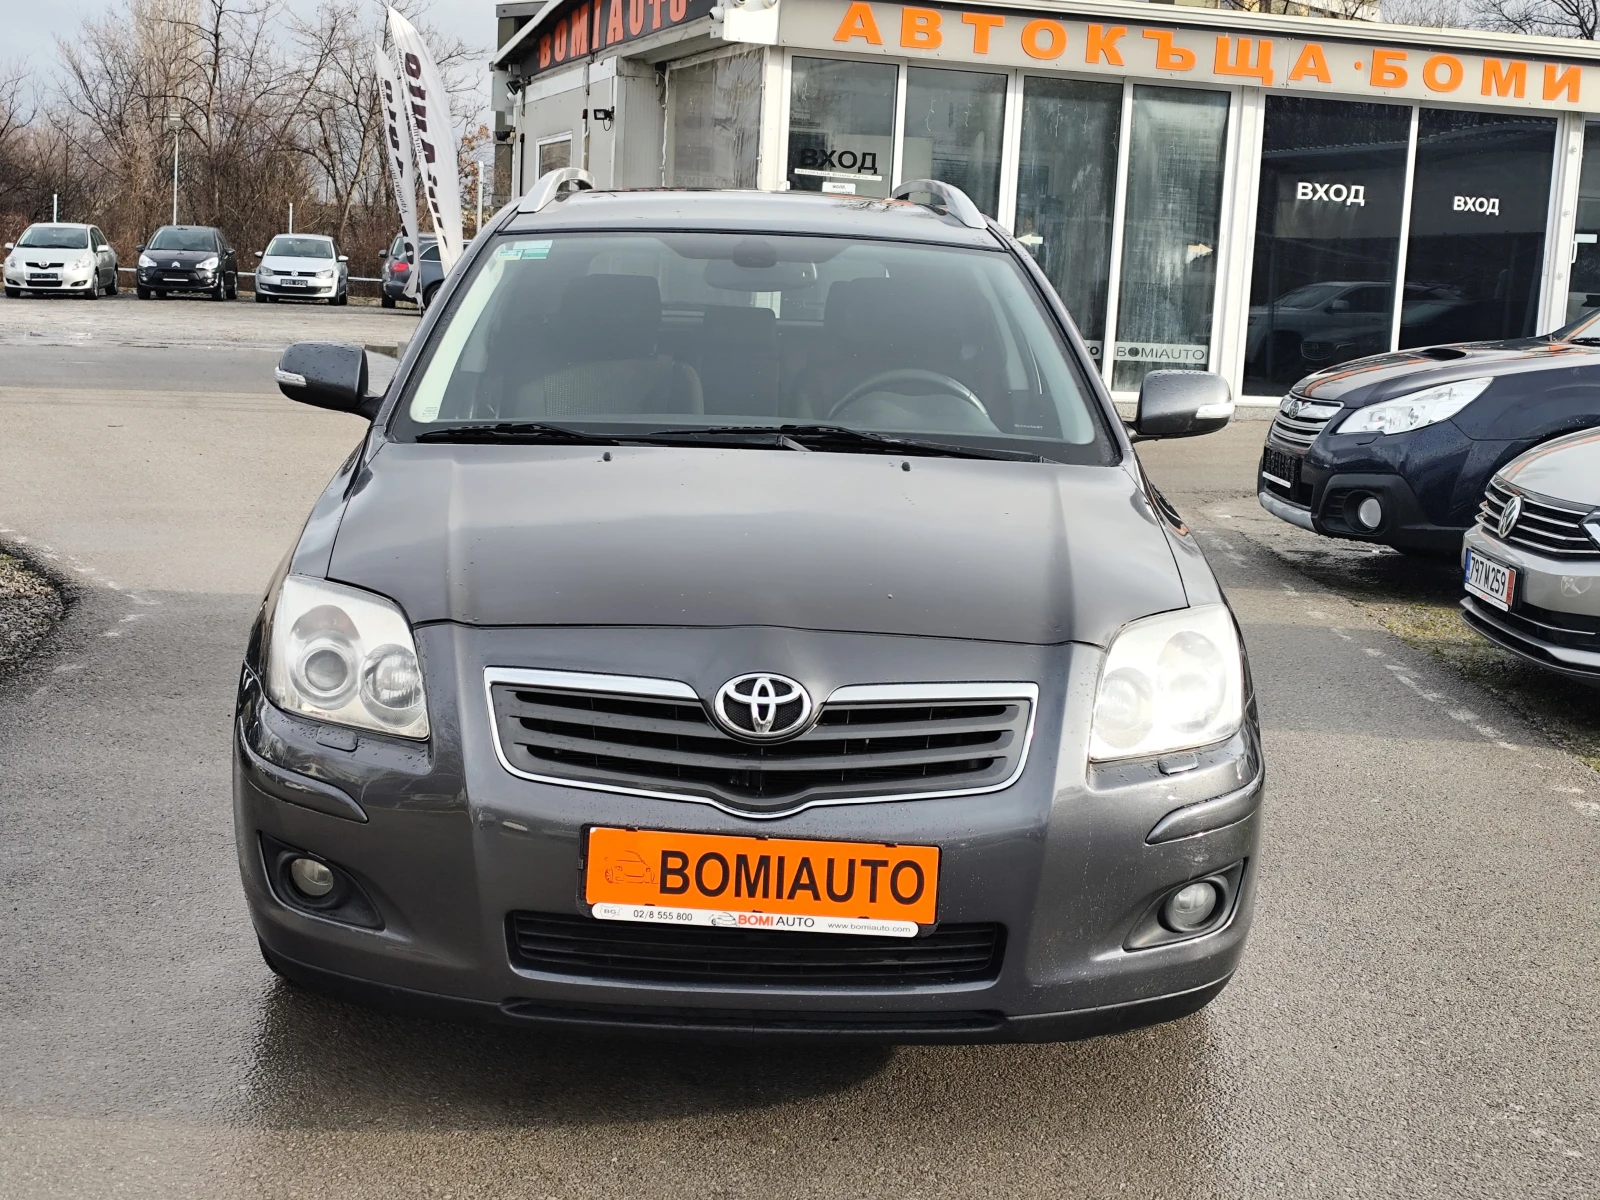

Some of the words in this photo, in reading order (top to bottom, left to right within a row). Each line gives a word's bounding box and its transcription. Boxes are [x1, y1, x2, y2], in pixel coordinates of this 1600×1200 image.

[833, 2, 1332, 86] АВТОКЪЩА
[801, 148, 877, 174] ВХОД
[1297, 182, 1365, 206] ВХОД
[1453, 196, 1500, 216] ВХОД
[659, 850, 925, 905] BOMIAUTO
[633, 909, 654, 919] 02/8
[657, 911, 674, 920] 555
[676, 912, 693, 921] 800
[827, 922, 911, 933] www.bomiauto.com
